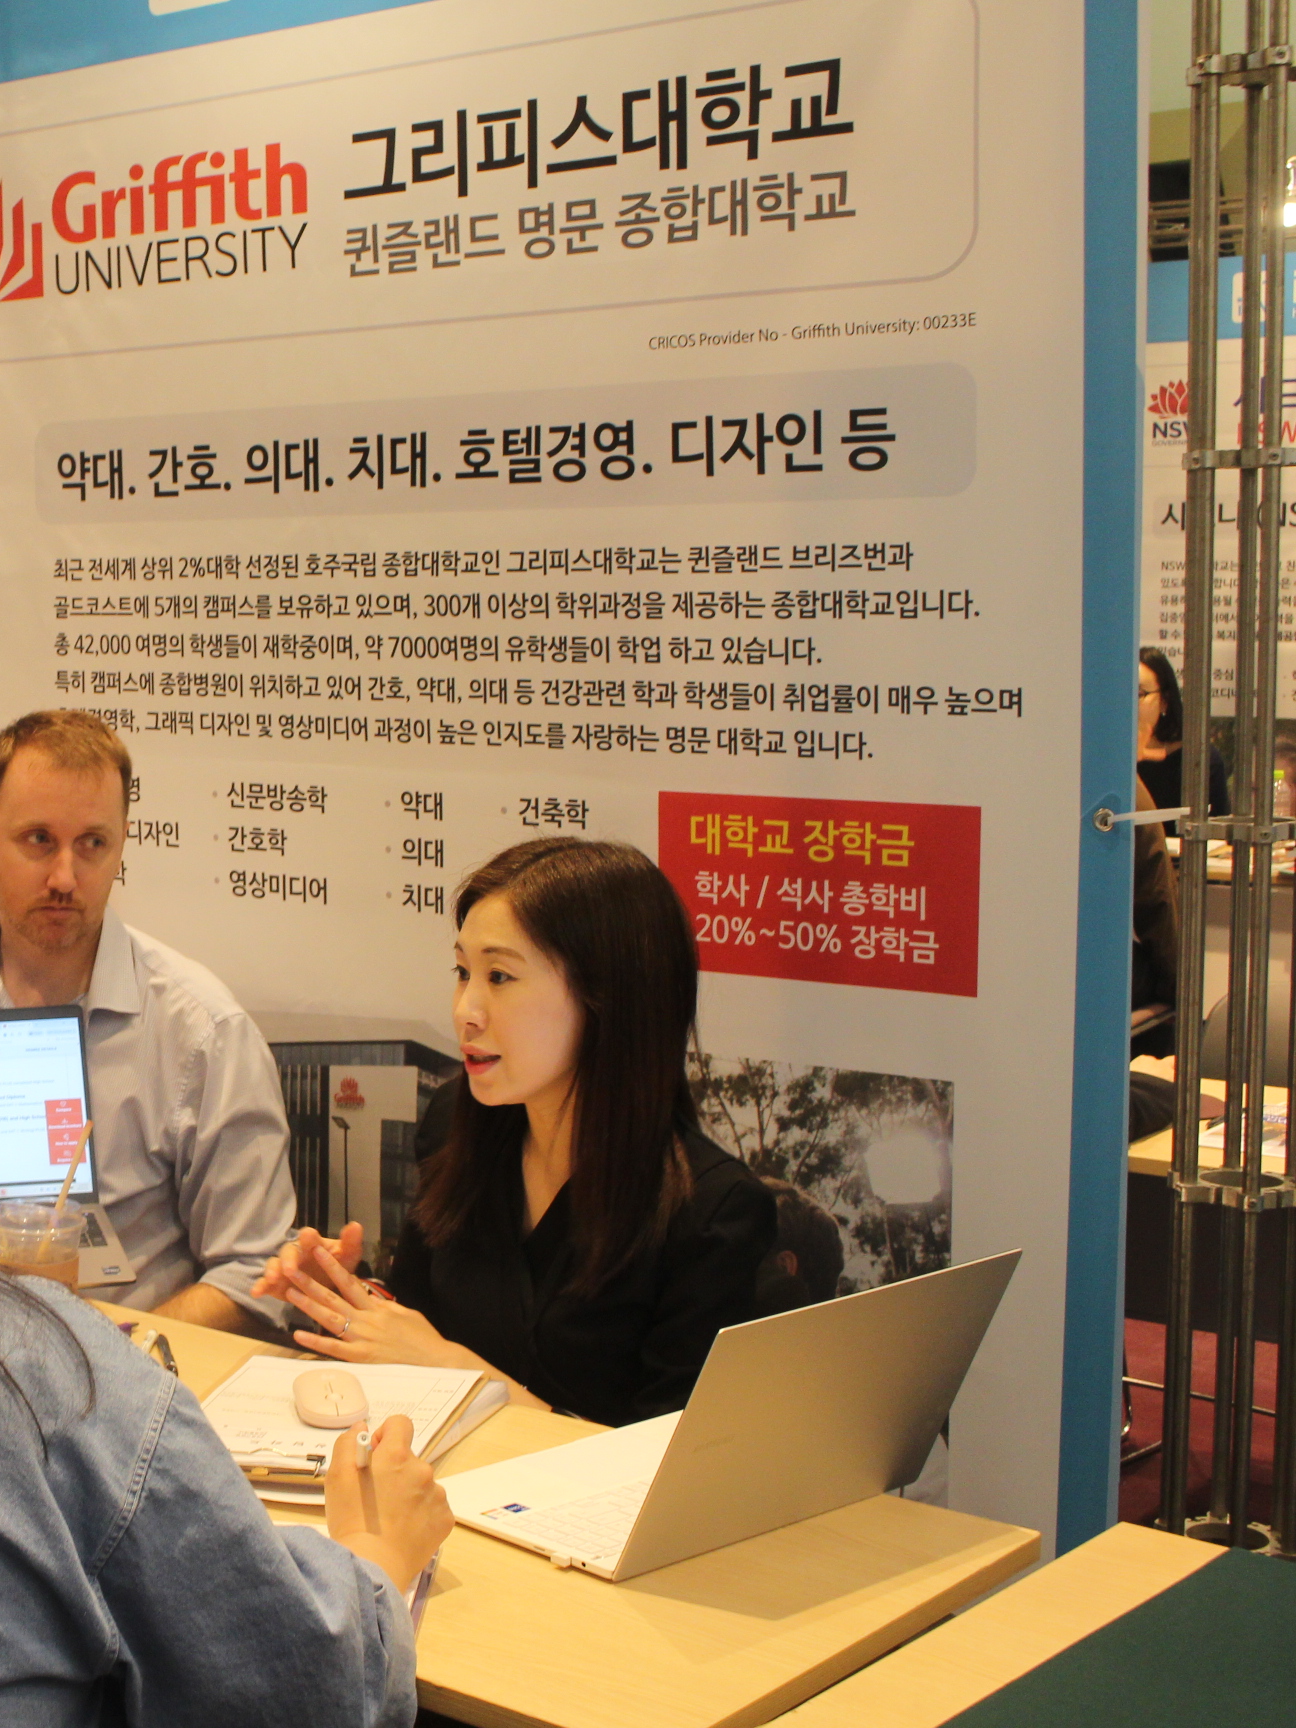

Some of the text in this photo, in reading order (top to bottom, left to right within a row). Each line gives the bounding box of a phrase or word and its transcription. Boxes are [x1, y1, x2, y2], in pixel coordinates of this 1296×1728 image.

[343, 57, 854, 201] 그리피스대학교
[51, 142, 308, 245] Griffith
[343, 170, 857, 278] 퀸즐랜드 명문 종합대학교
[55, 222, 308, 296] UNIVERSITY
[648, 334, 696, 351] CRICOS
[699, 329, 754, 348] Provider
[759, 328, 779, 343] No
[791, 322, 841, 341] Griffith
[845, 317, 920, 339] University:
[923, 312, 977, 331] 00233E
[57, 407, 897, 501] 약대. 간호. 의대. 치대. 호텔경영. 디자인 등
[53, 542, 914, 581] 최근 전세계 상위 2%대학 선정된 호주국립 종합대학교인 그리피스대학교는 퀸즐랜드 브리즈번과
[53, 590, 980, 620] 골드코스트에 5개의 캠퍼스를 보유하고 있으며, 300개 이상의 학위과정을 제공하는 종합대학교입니다.
[54, 632, 822, 666] 총 42,000 여명의 학생들이 재학중이며, 약 7000여명의 유학생들이 학업 하고 있습니다.
[54, 670, 1023, 718] 특히 캠퍼스에 종합병원이 위치하고 있어 간호, 약대, 의대 등 건강관련 학과 학생들이 취업률이 매우 높으며
[145, 711, 194, 735] 그래픽
[200, 712, 250, 737] 디자인
[256, 713, 273, 738] 및
[278, 714, 369, 742] 영상미디어
[374, 717, 432, 744] 과정이
[437, 718, 478, 746] 높은
[482, 720, 567, 750] 인지도를
[571, 724, 659, 753] 자랑하는
[666, 726, 711, 755] 명문
[717, 727, 787, 756] 대학교
[794, 730, 874, 760] 입니다.
[227, 781, 328, 814] 신문방송학
[400, 790, 444, 822] 약대
[518, 797, 589, 830] 건축학
[228, 825, 288, 857] 간호학
[402, 838, 445, 868] 의대
[689, 814, 915, 868] 대학교 장학금
[229, 869, 328, 905] 영상미디어
[402, 885, 445, 915] 치대
[694, 872, 927, 921] 학사 / 석사 총학비
[694, 913, 940, 965] 20%~50% 장학금
